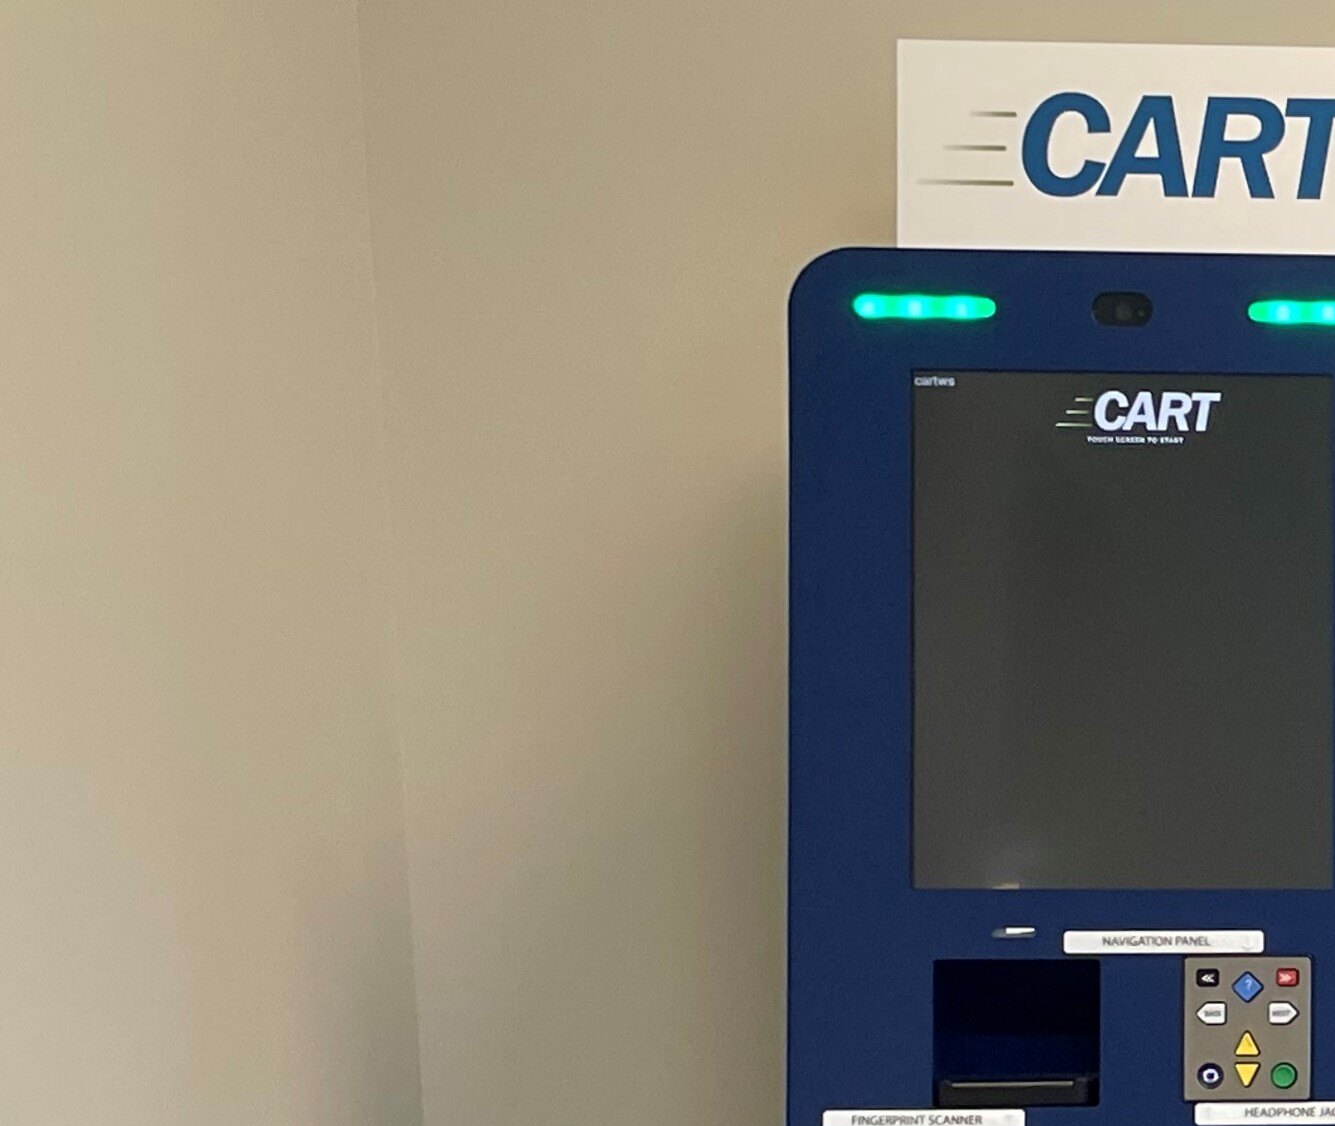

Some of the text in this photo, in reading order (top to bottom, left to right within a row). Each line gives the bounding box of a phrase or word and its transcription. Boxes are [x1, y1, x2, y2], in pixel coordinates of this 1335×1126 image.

[1093, 390, 1222, 432] CART
[1147, 436, 1158, 444] TO
[1102, 935, 1211, 947] NAVIGATION PANEL
[1244, 1107, 1317, 1118] HEADPHONE
[851, 1114, 983, 1126] FINGERPRINT SCANNER
